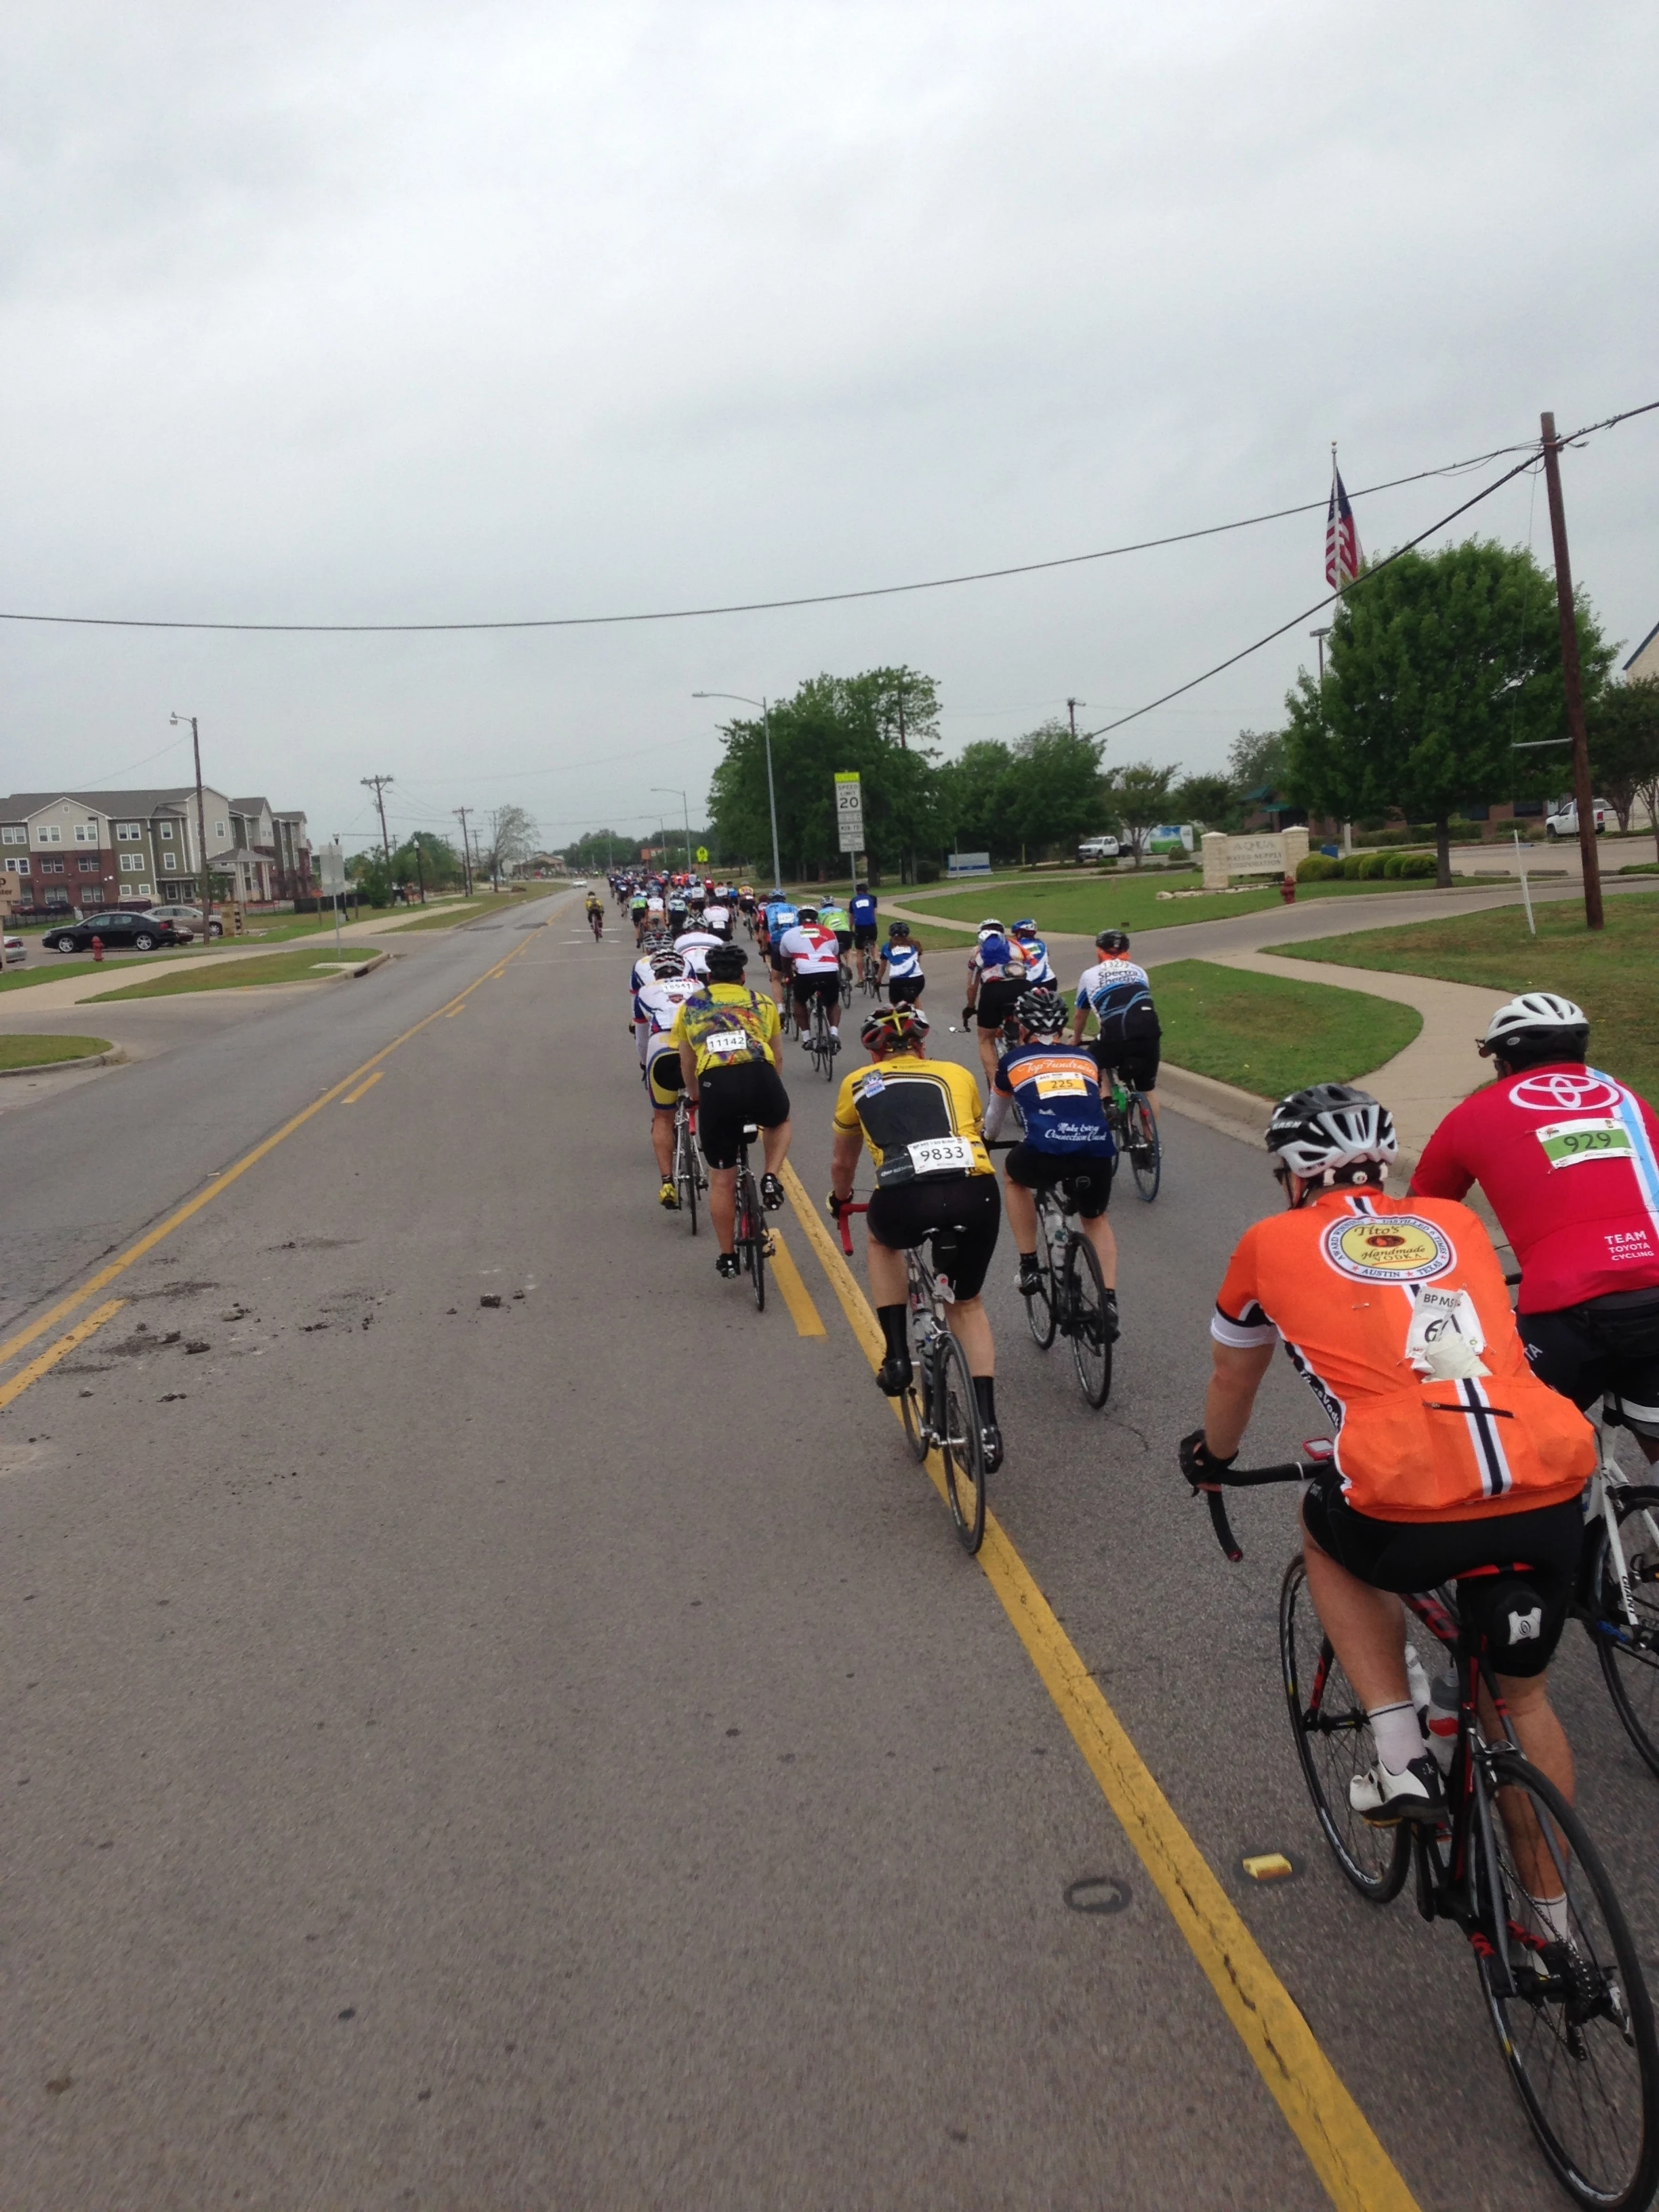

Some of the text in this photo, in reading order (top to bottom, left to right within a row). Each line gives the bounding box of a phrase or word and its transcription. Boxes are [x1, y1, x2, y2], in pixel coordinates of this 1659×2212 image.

[840, 797, 859, 808] 20
[1099, 971, 1138, 980] Spectra
[710, 1037, 744, 1048] 11142
[1018, 1063, 1043, 1073] Top
[1050, 1080, 1073, 1088] 225
[1563, 1132, 1611, 1152] 929
[920, 1147, 964, 1162] 9833
[1355, 1225, 1400, 1237] Tito's
[1604, 1231, 1647, 1245] TEAM
[1330, 1237, 1345, 1261] AWARD
[1361, 1245, 1425, 1261] Handmade
[1608, 1242, 1651, 1253] TOYOTA
[1612, 1251, 1654, 1261] CYCLING
[1362, 1267, 1400, 1277] AUSTIN
[1417, 1261, 1443, 1275] TEXAS
[1424, 1294, 1438, 1303] BP
